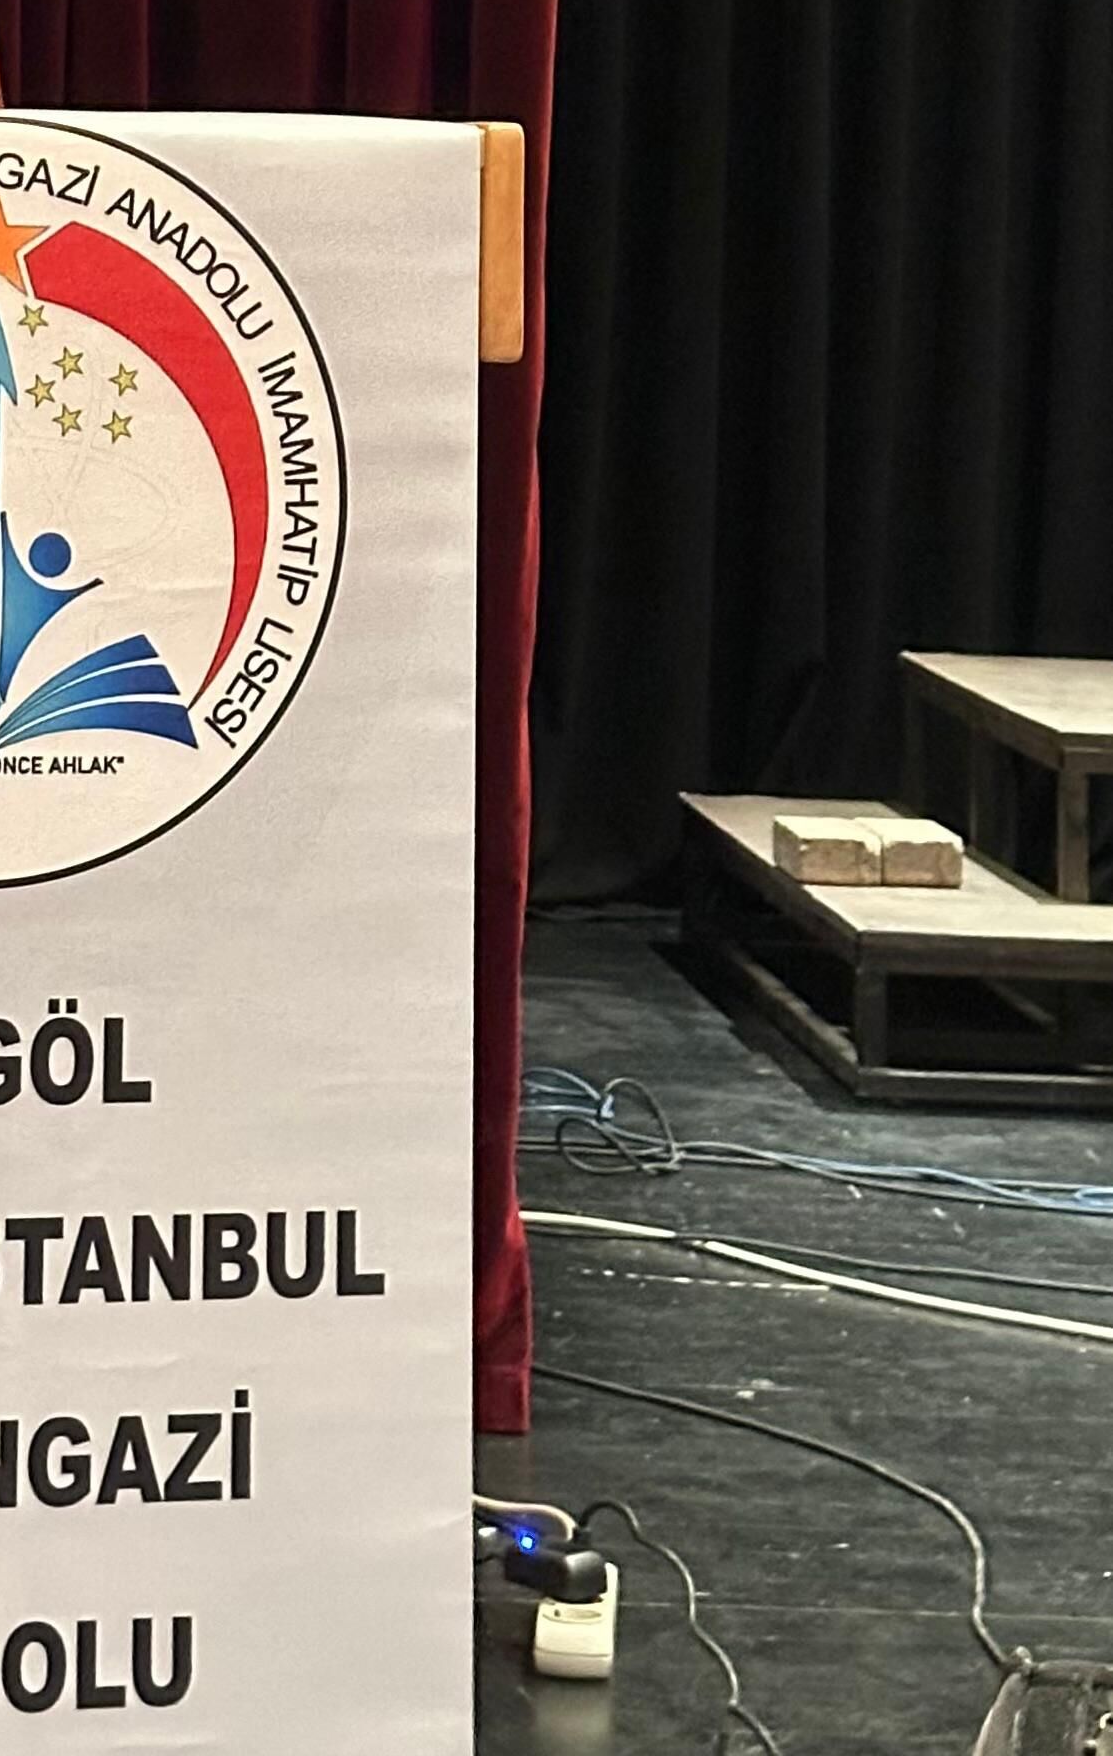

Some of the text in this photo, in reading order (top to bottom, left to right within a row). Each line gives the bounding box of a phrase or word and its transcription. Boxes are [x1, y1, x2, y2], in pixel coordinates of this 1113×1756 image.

[105, 187, 274, 341] ANADOLU
[204, 617, 294, 748] LİSESİ
[48, 755, 125, 775] AHLAK"
